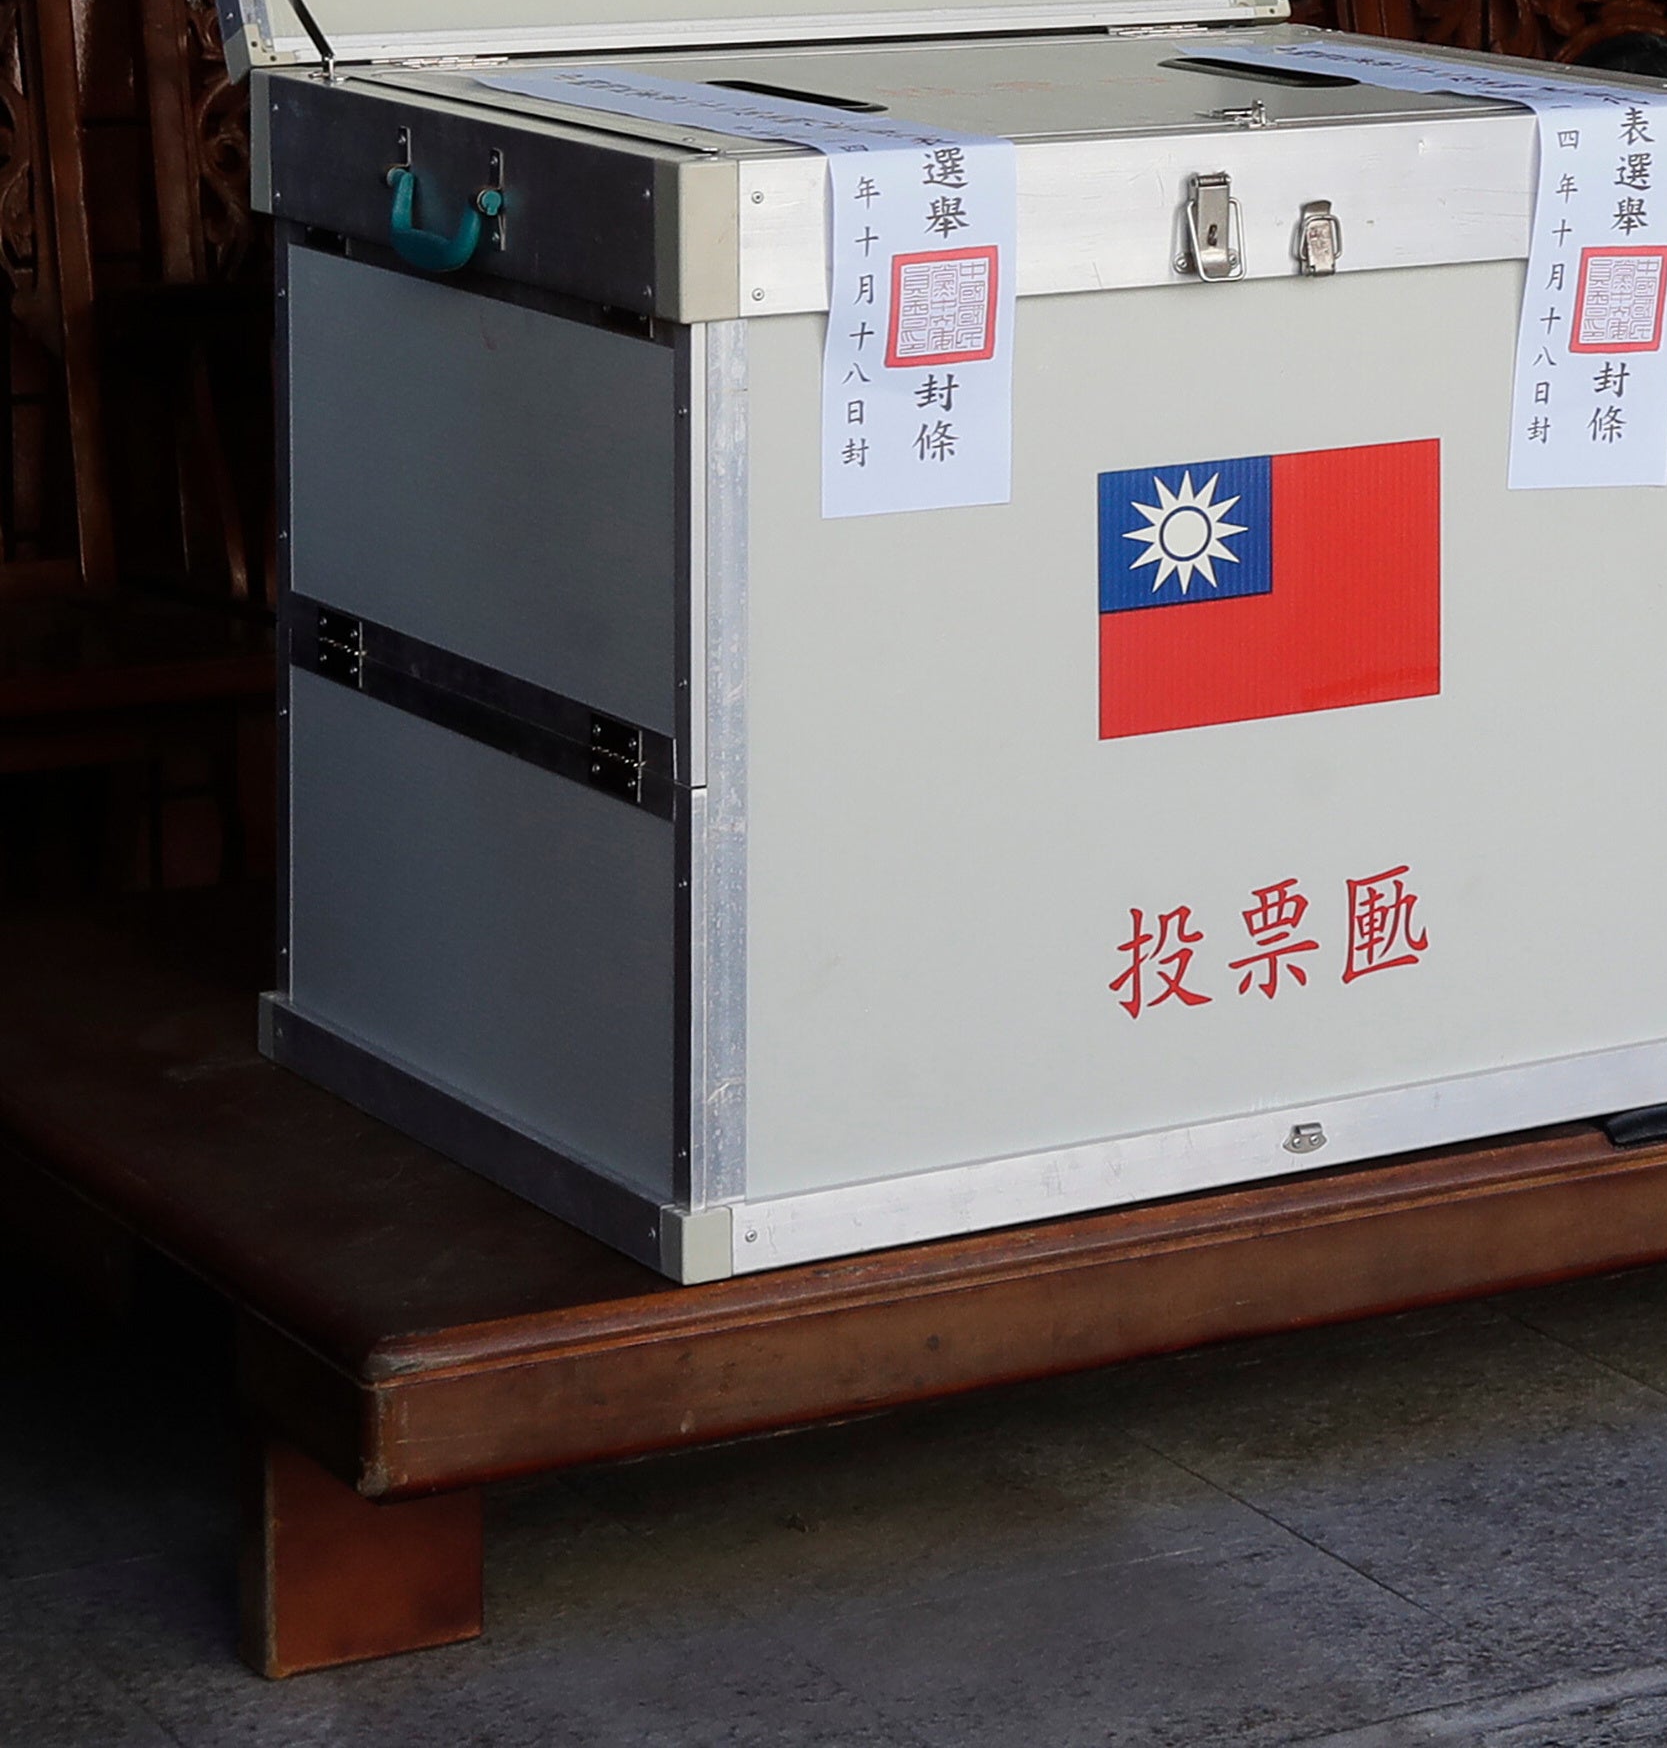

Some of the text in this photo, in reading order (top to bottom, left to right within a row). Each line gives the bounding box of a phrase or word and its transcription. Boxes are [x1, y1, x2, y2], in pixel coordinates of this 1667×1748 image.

[911, 372, 962, 464] 封條
[1585, 360, 1632, 445] 封條
[1107, 864, 1431, 1020] 投票匭
